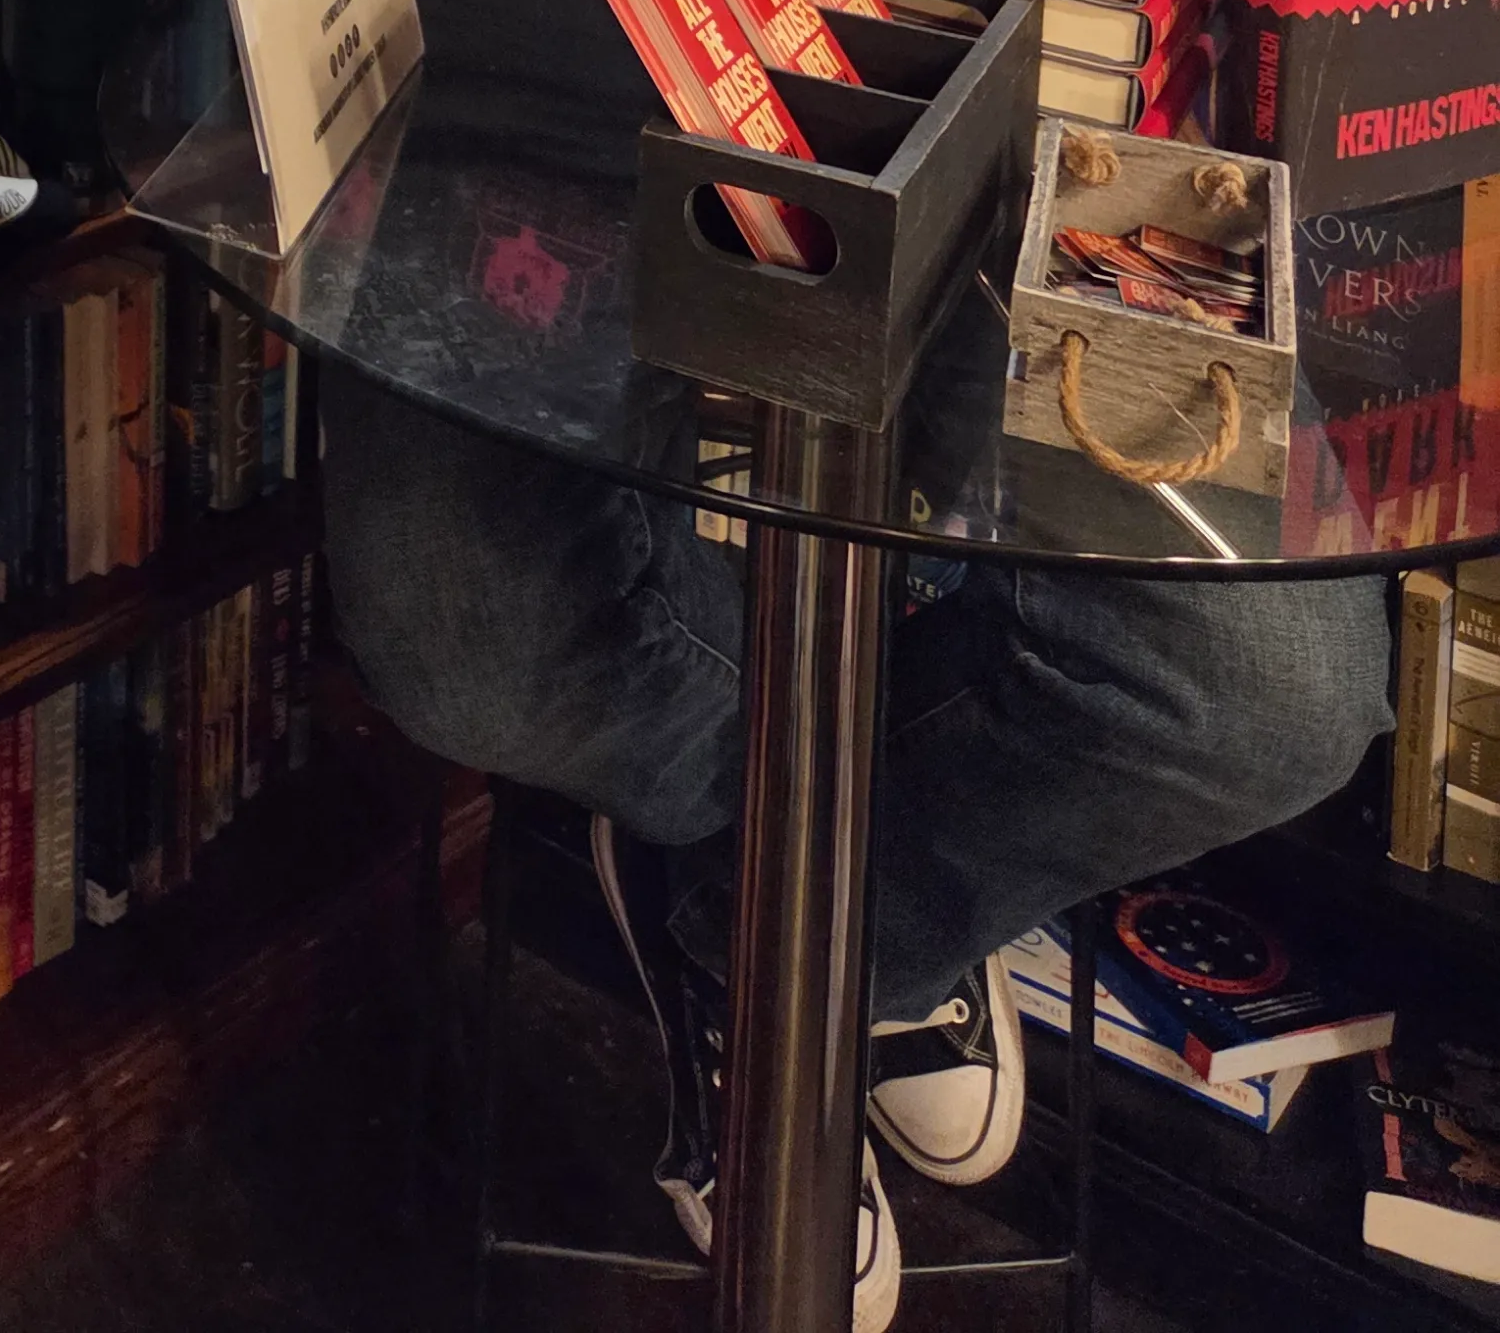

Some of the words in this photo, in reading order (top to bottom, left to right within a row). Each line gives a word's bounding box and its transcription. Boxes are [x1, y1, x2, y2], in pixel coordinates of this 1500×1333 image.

[695, 20, 735, 71] THE
[1258, 30, 1280, 70] KEN
[708, 52, 769, 129] HOUSES
[1254, 70, 1279, 144] HASTINGS
[737, 97, 789, 154] WENT
